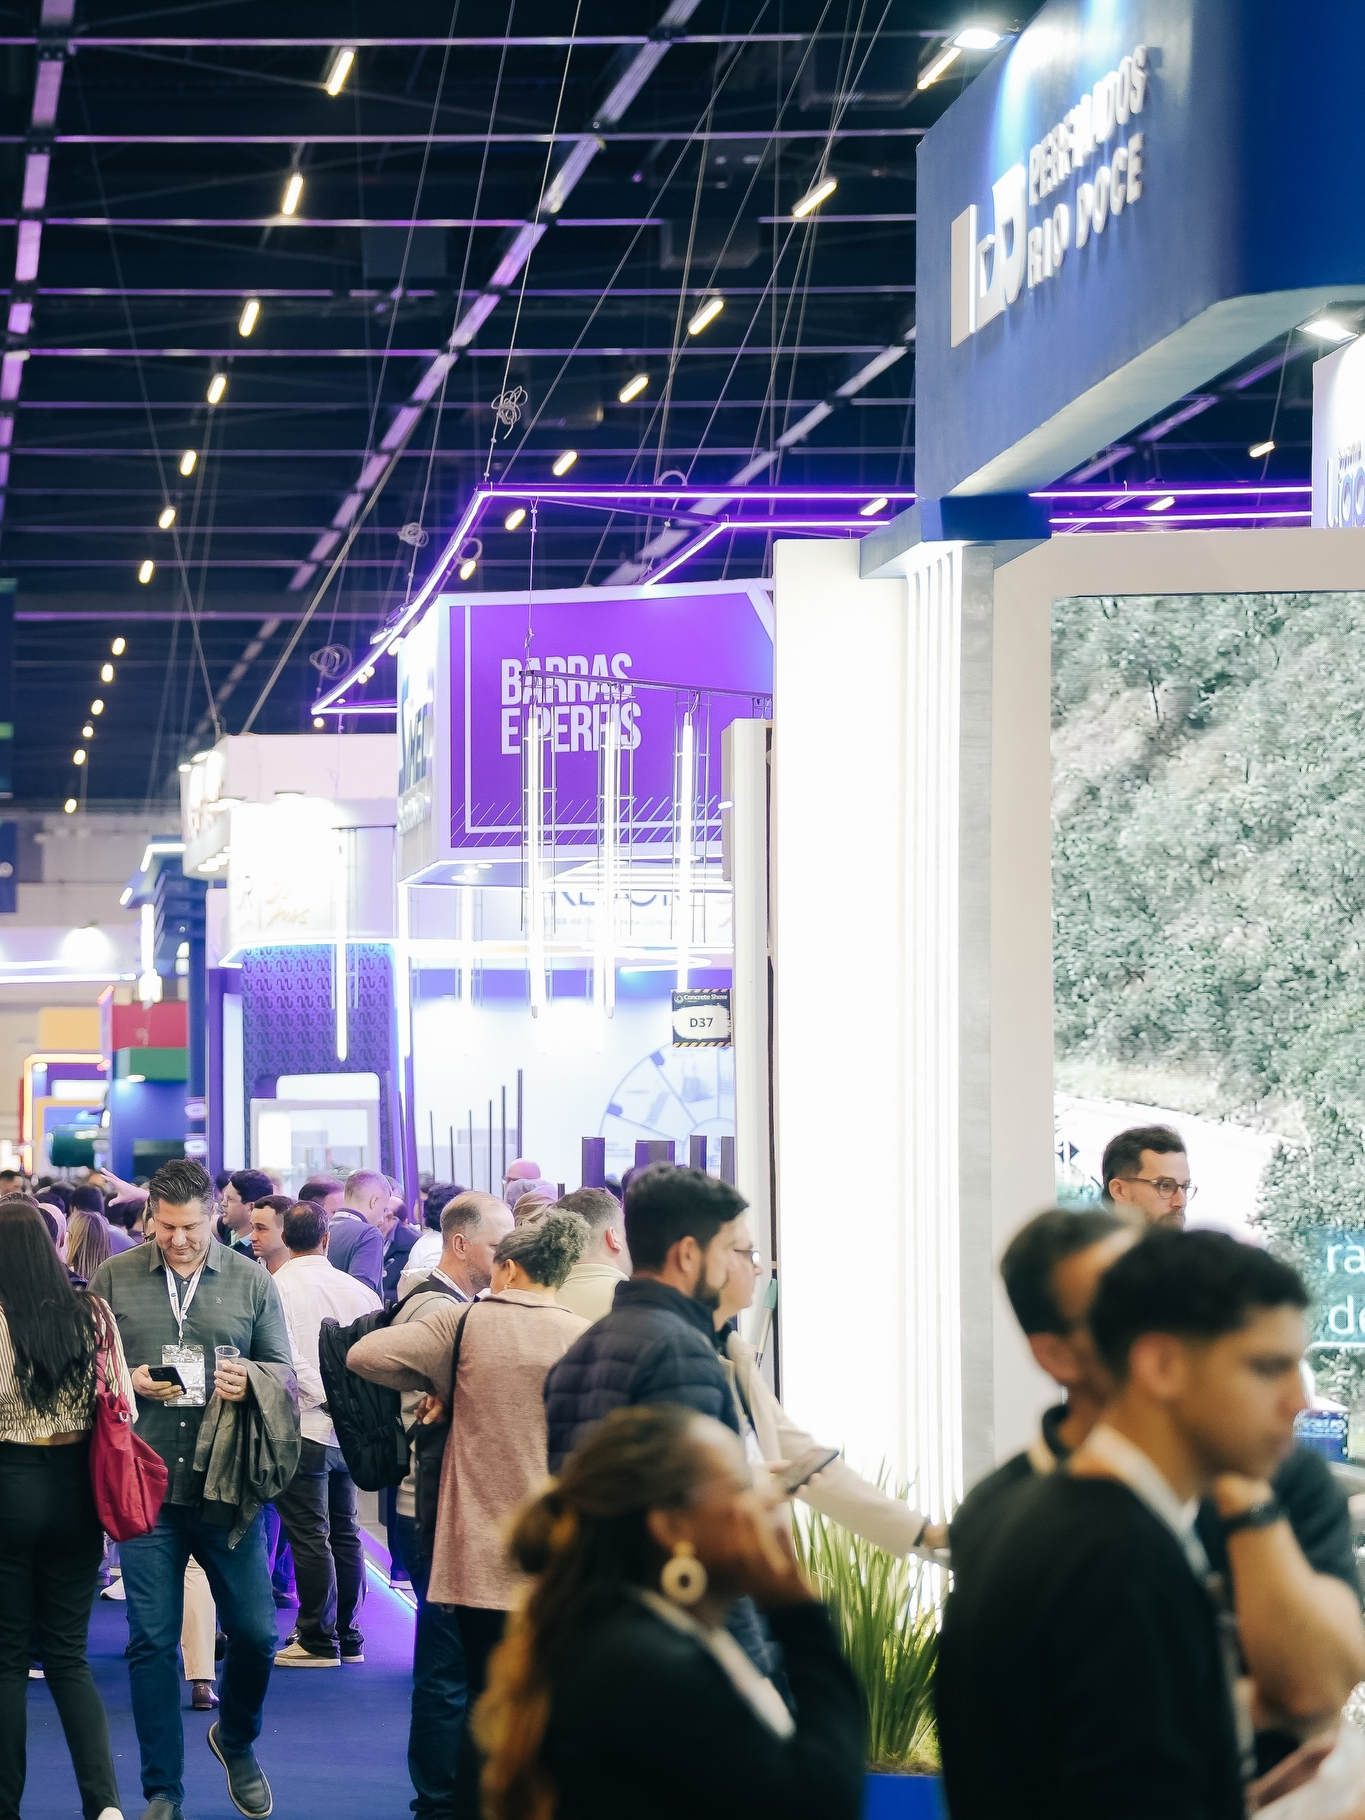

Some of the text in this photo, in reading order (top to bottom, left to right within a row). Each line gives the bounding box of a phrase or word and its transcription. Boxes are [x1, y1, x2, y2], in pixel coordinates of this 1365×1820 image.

[1027, 133, 1145, 289] RIO DOCE
[501, 653, 633, 706] BARRAS
[501, 707, 521, 755] E
[689, 1017, 714, 1028] D37
